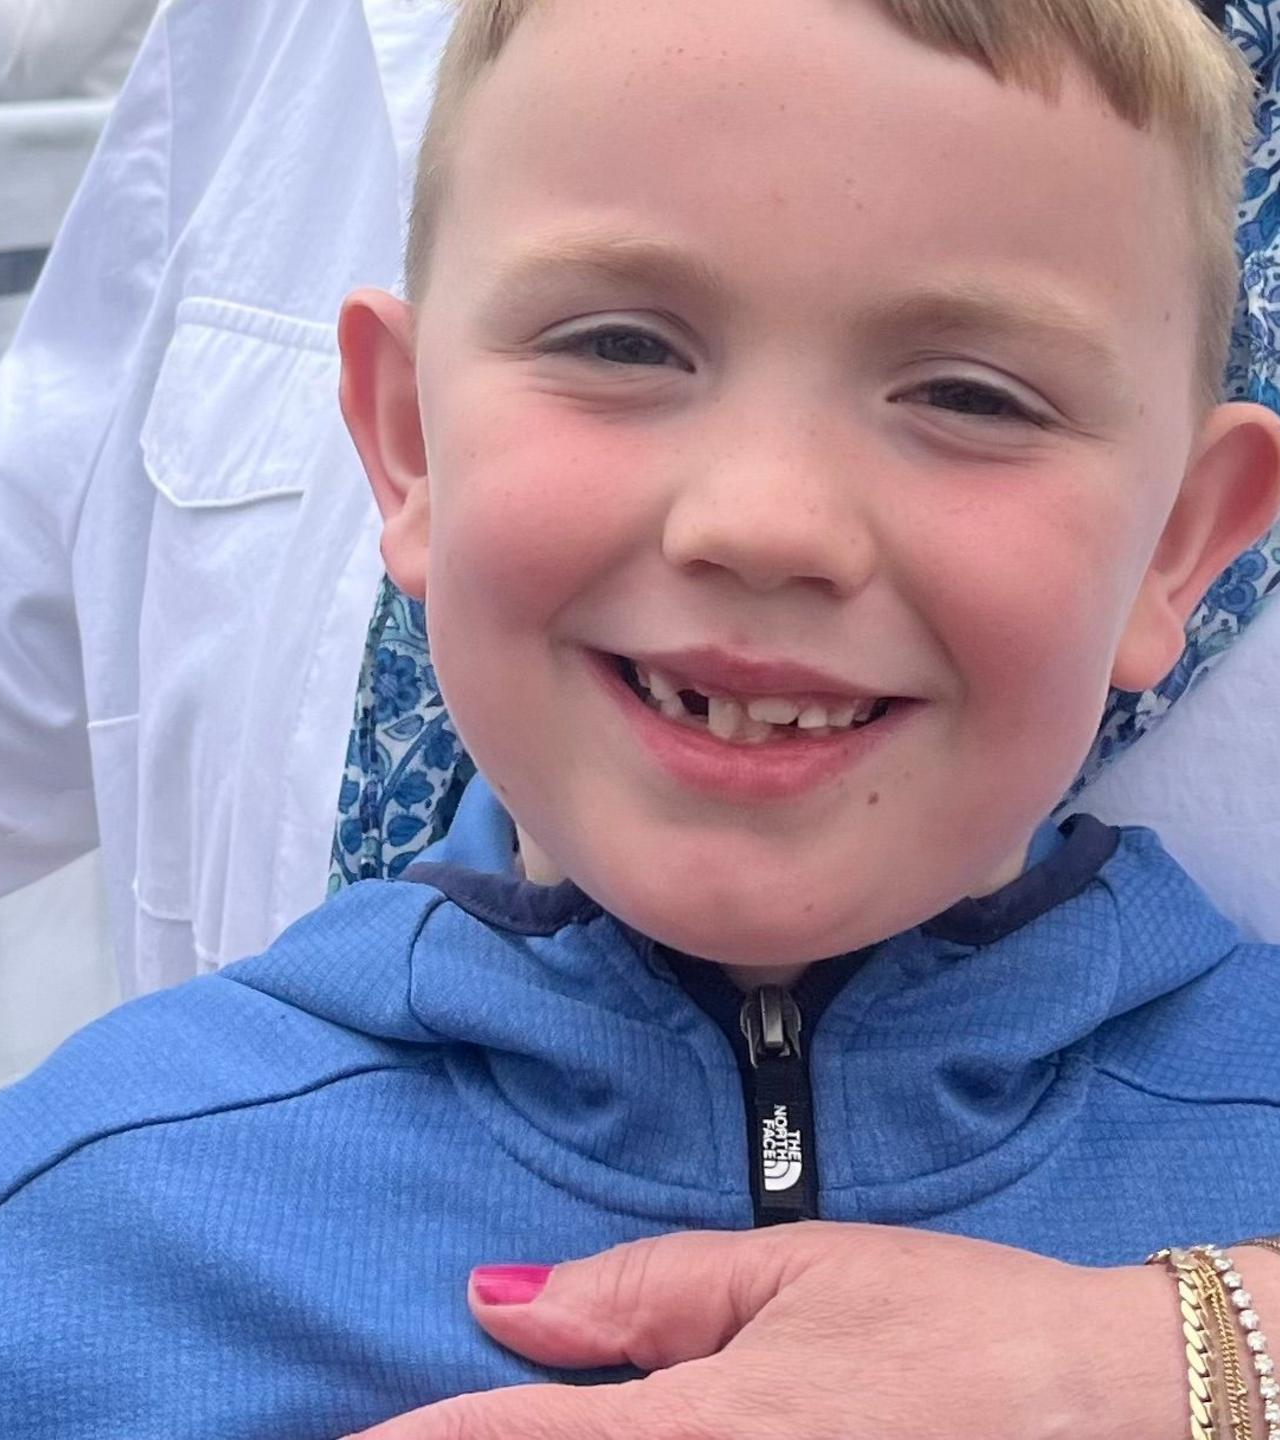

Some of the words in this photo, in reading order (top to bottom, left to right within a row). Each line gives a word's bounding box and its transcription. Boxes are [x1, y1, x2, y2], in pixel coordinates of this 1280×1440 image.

[762, 1119, 776, 1160] FACE
[774, 1104, 788, 1160] NORTH
[787, 1129, 802, 1161] THE
